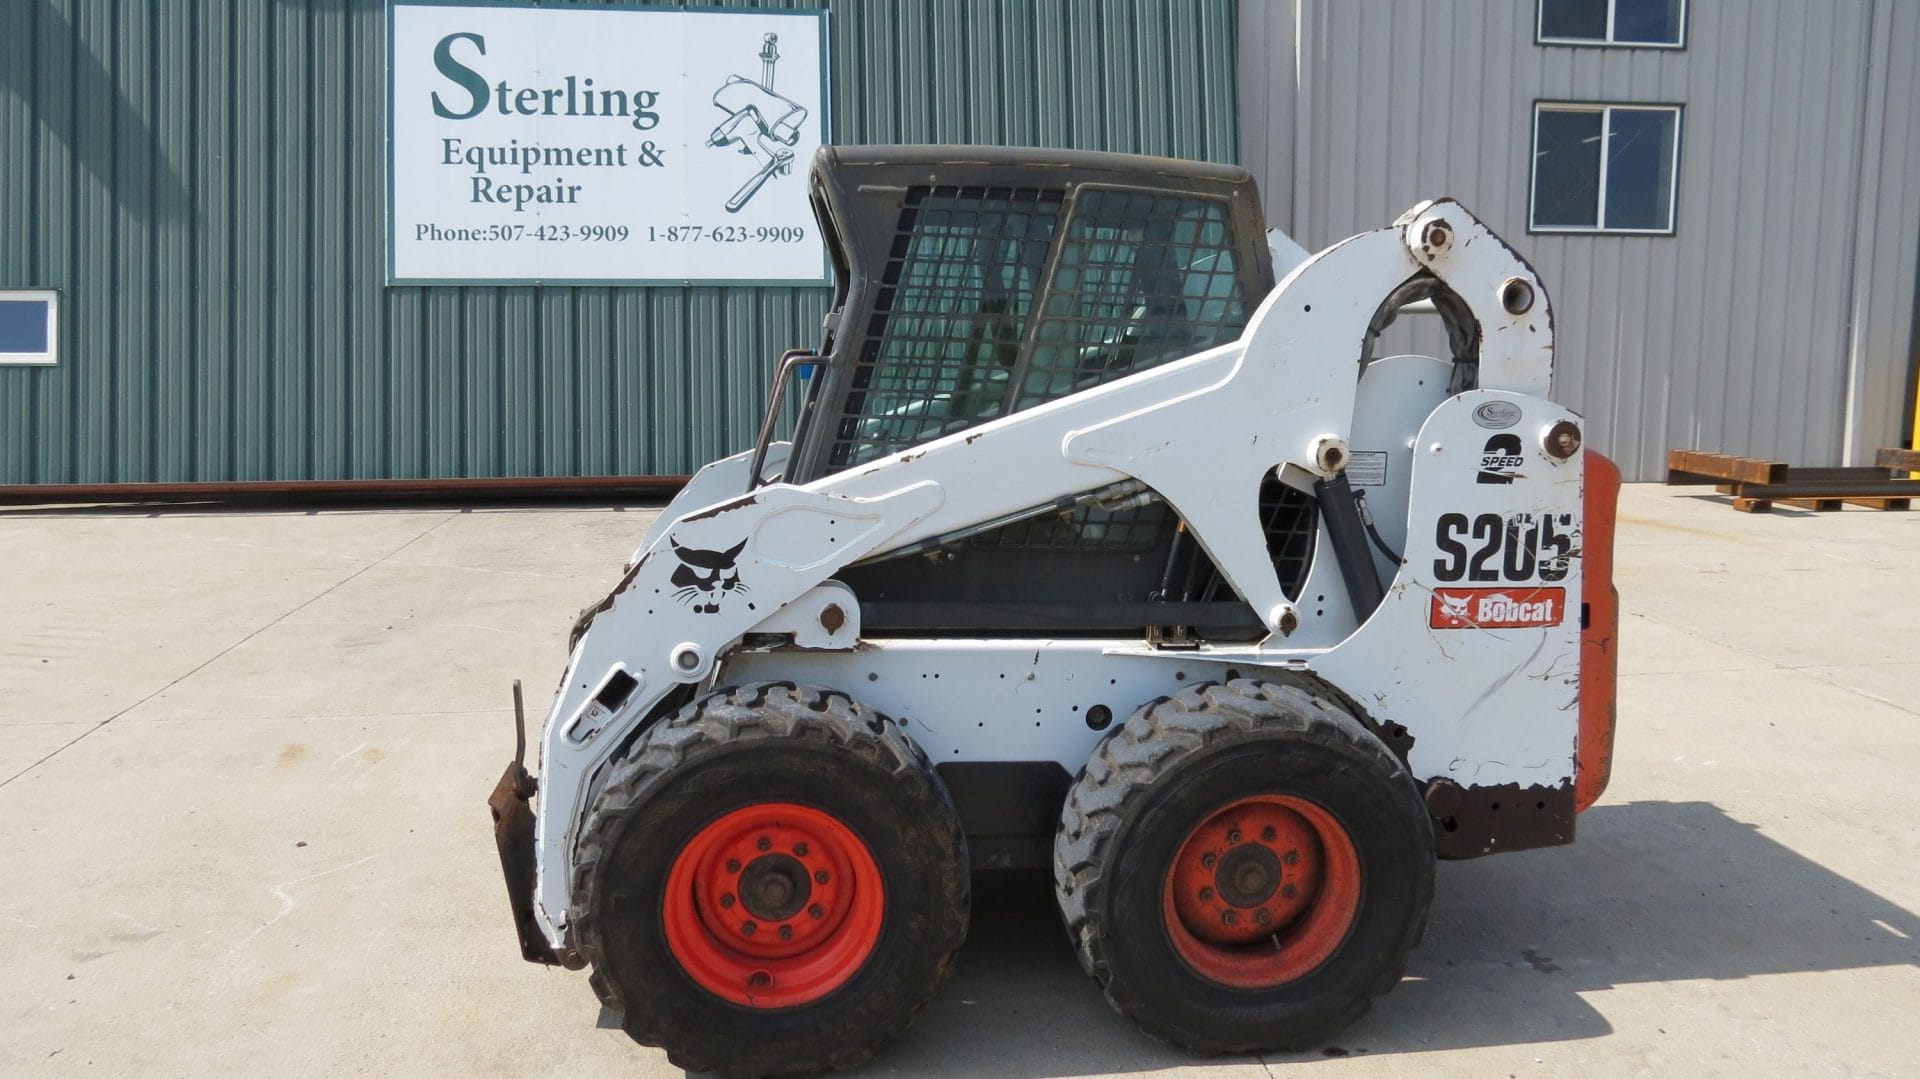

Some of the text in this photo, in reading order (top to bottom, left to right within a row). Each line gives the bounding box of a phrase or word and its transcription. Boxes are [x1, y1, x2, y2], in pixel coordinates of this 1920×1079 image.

[430, 32, 660, 131] Sterling
[441, 138, 665, 174] Equipment &
[470, 177, 582, 212] Repair
[415, 223, 804, 243] Phone:507-423-9909 1-877-623-9909
[1477, 433, 1523, 484] 2
[1480, 456, 1524, 467] SPEED
[1433, 512, 1572, 582] S205
[1477, 597, 1554, 623] Bobcat
